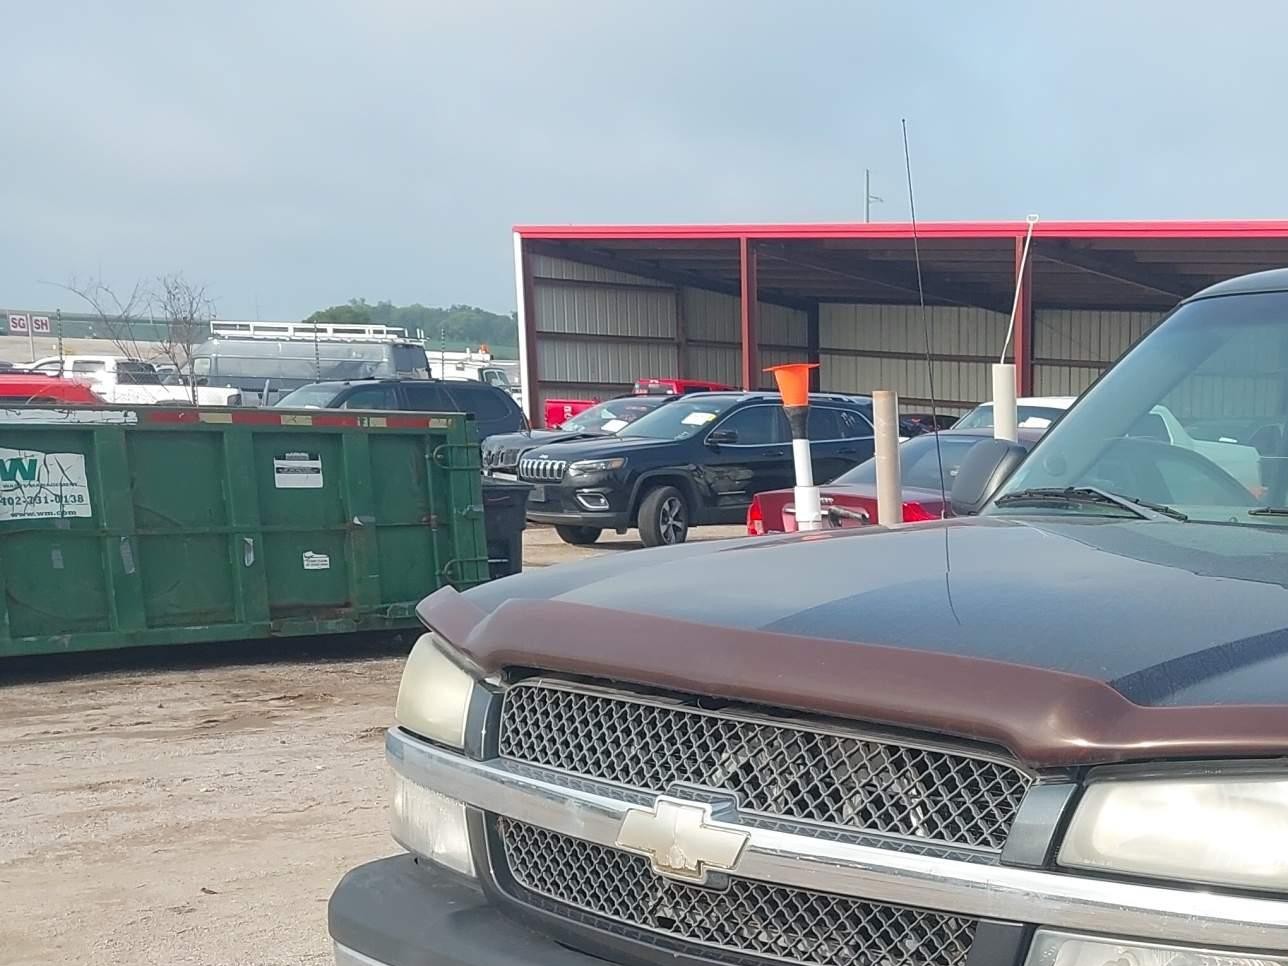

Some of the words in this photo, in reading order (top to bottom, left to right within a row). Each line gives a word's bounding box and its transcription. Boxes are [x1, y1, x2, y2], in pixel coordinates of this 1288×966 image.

[11, 317, 26, 329] SG
[33, 318, 49, 331] SH
[10, 510, 77, 518] www.wm.com
